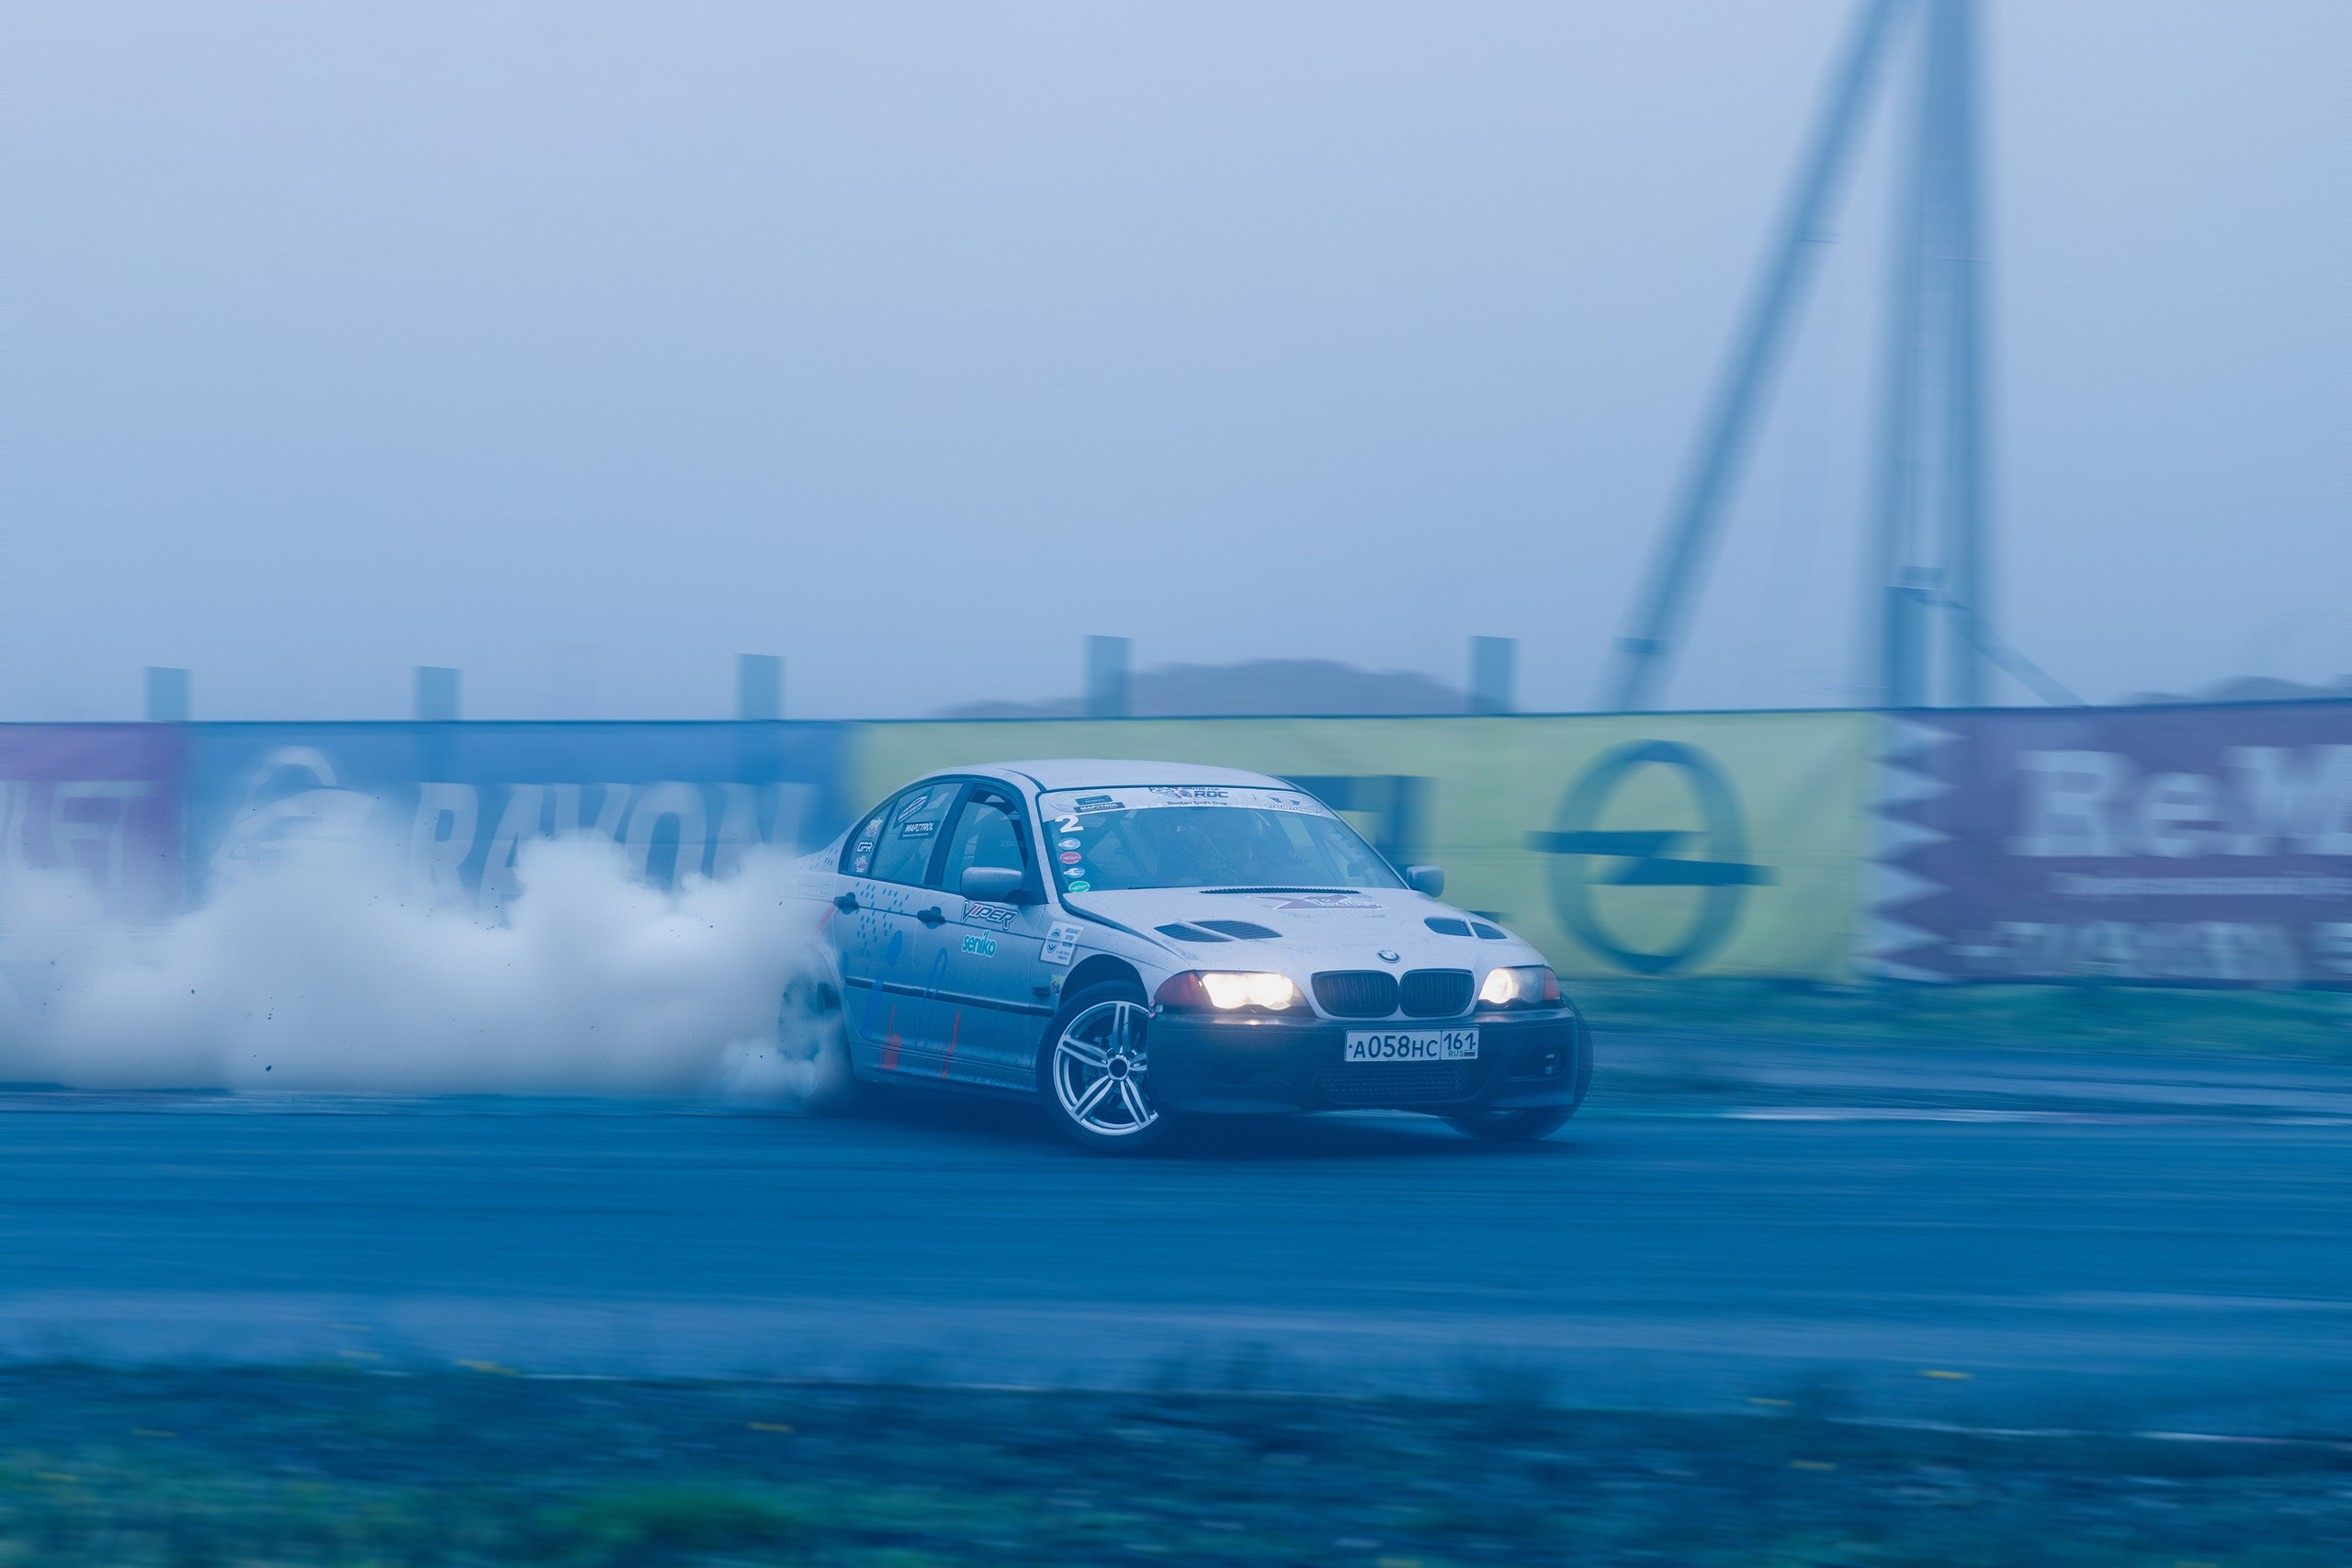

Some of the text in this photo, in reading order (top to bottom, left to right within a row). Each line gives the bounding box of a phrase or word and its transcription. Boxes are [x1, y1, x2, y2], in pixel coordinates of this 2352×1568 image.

[1193, 790, 1228, 798] RDC
[1055, 814, 1084, 833] 2
[961, 900, 1019, 931] VIPER
[961, 930, 997, 958] seniko
[1443, 1032, 1475, 1051] 161
[1448, 1049, 1464, 1057] RUS
